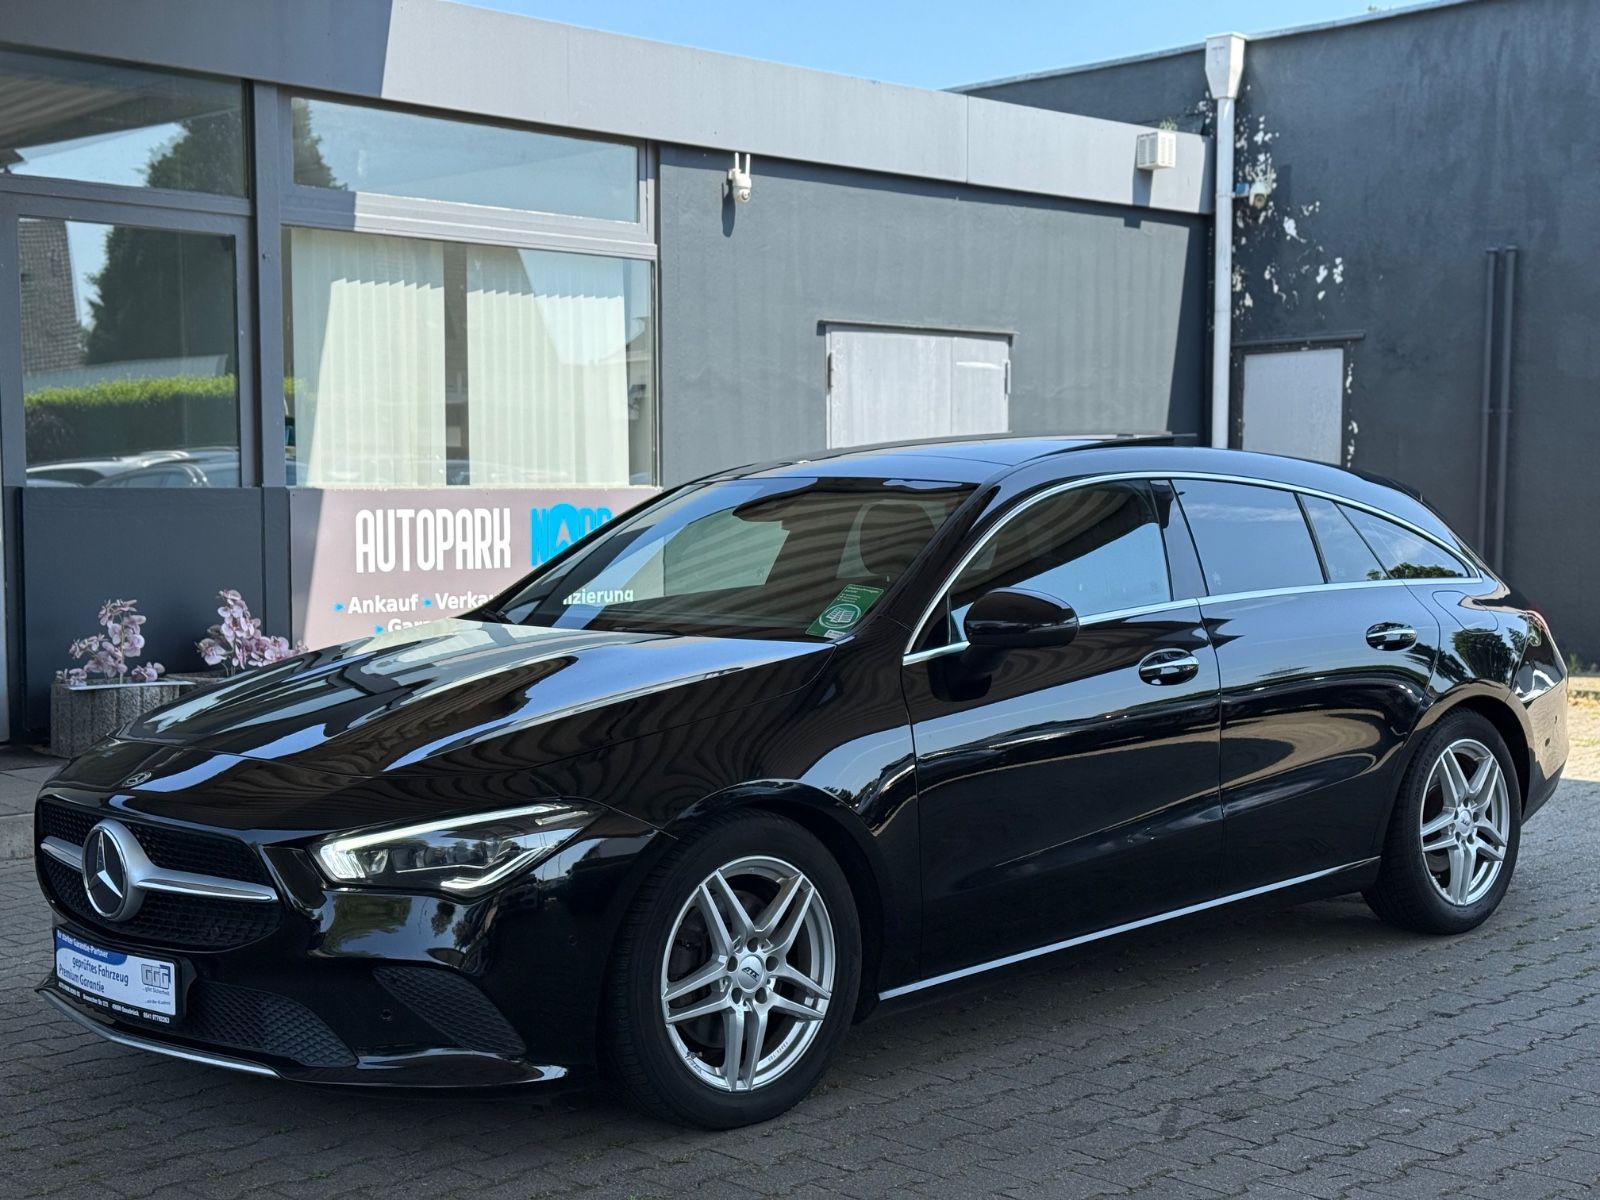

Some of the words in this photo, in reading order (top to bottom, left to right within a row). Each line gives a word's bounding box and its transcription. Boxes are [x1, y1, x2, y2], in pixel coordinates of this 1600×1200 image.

[355, 507, 512, 573] AUTOPARK
[347, 594, 419, 614] Ankauf
[434, 591, 495, 610] Verka
[58, 963, 80, 982] Premium
[79, 974, 106, 993] Garantie
[72, 956, 98, 976] geprüftes
[98, 965, 129, 987] Fahrzeug
